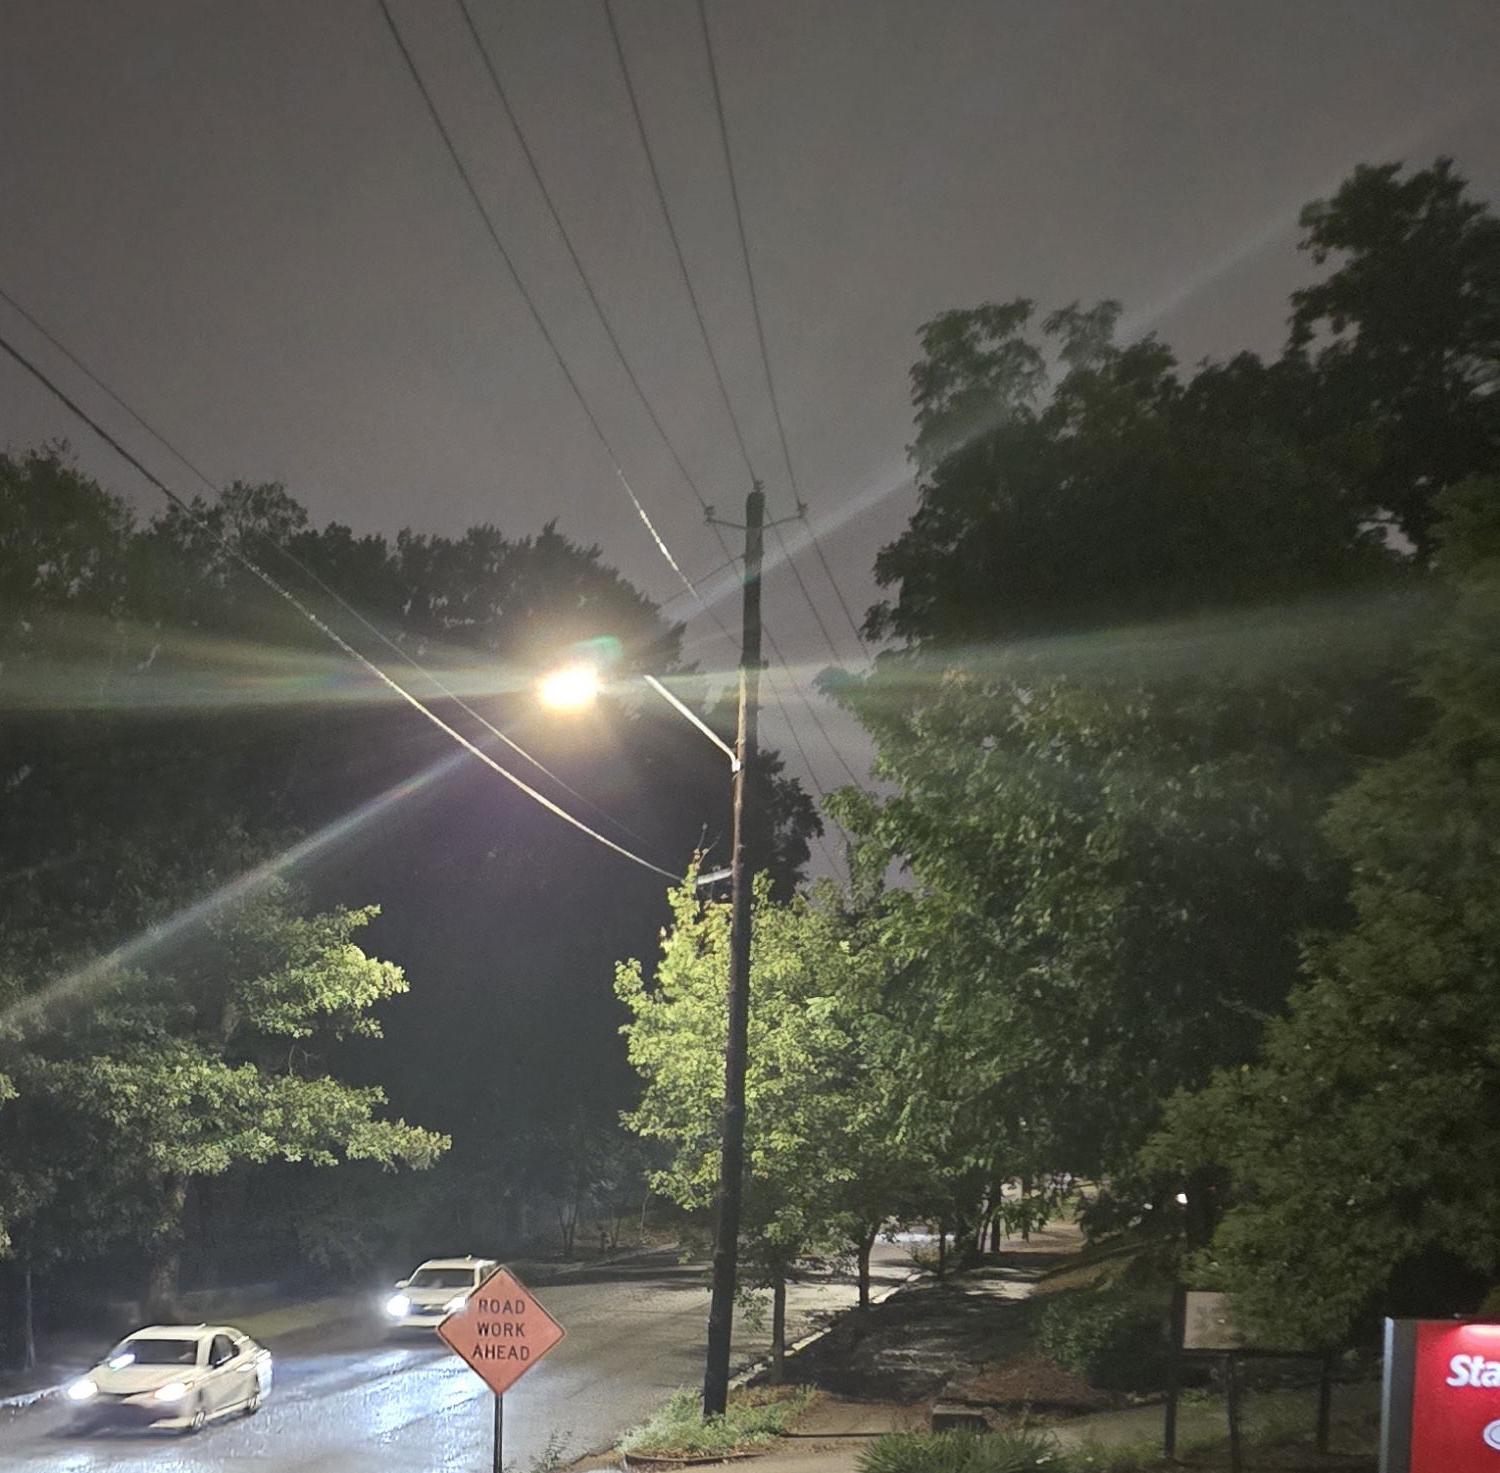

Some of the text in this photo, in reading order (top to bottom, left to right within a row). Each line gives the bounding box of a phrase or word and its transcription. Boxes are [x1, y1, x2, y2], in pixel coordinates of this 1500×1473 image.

[478, 1299, 525, 1314] ROAD
[477, 1322, 525, 1338] WORK
[471, 1343, 530, 1361] AHEAD
